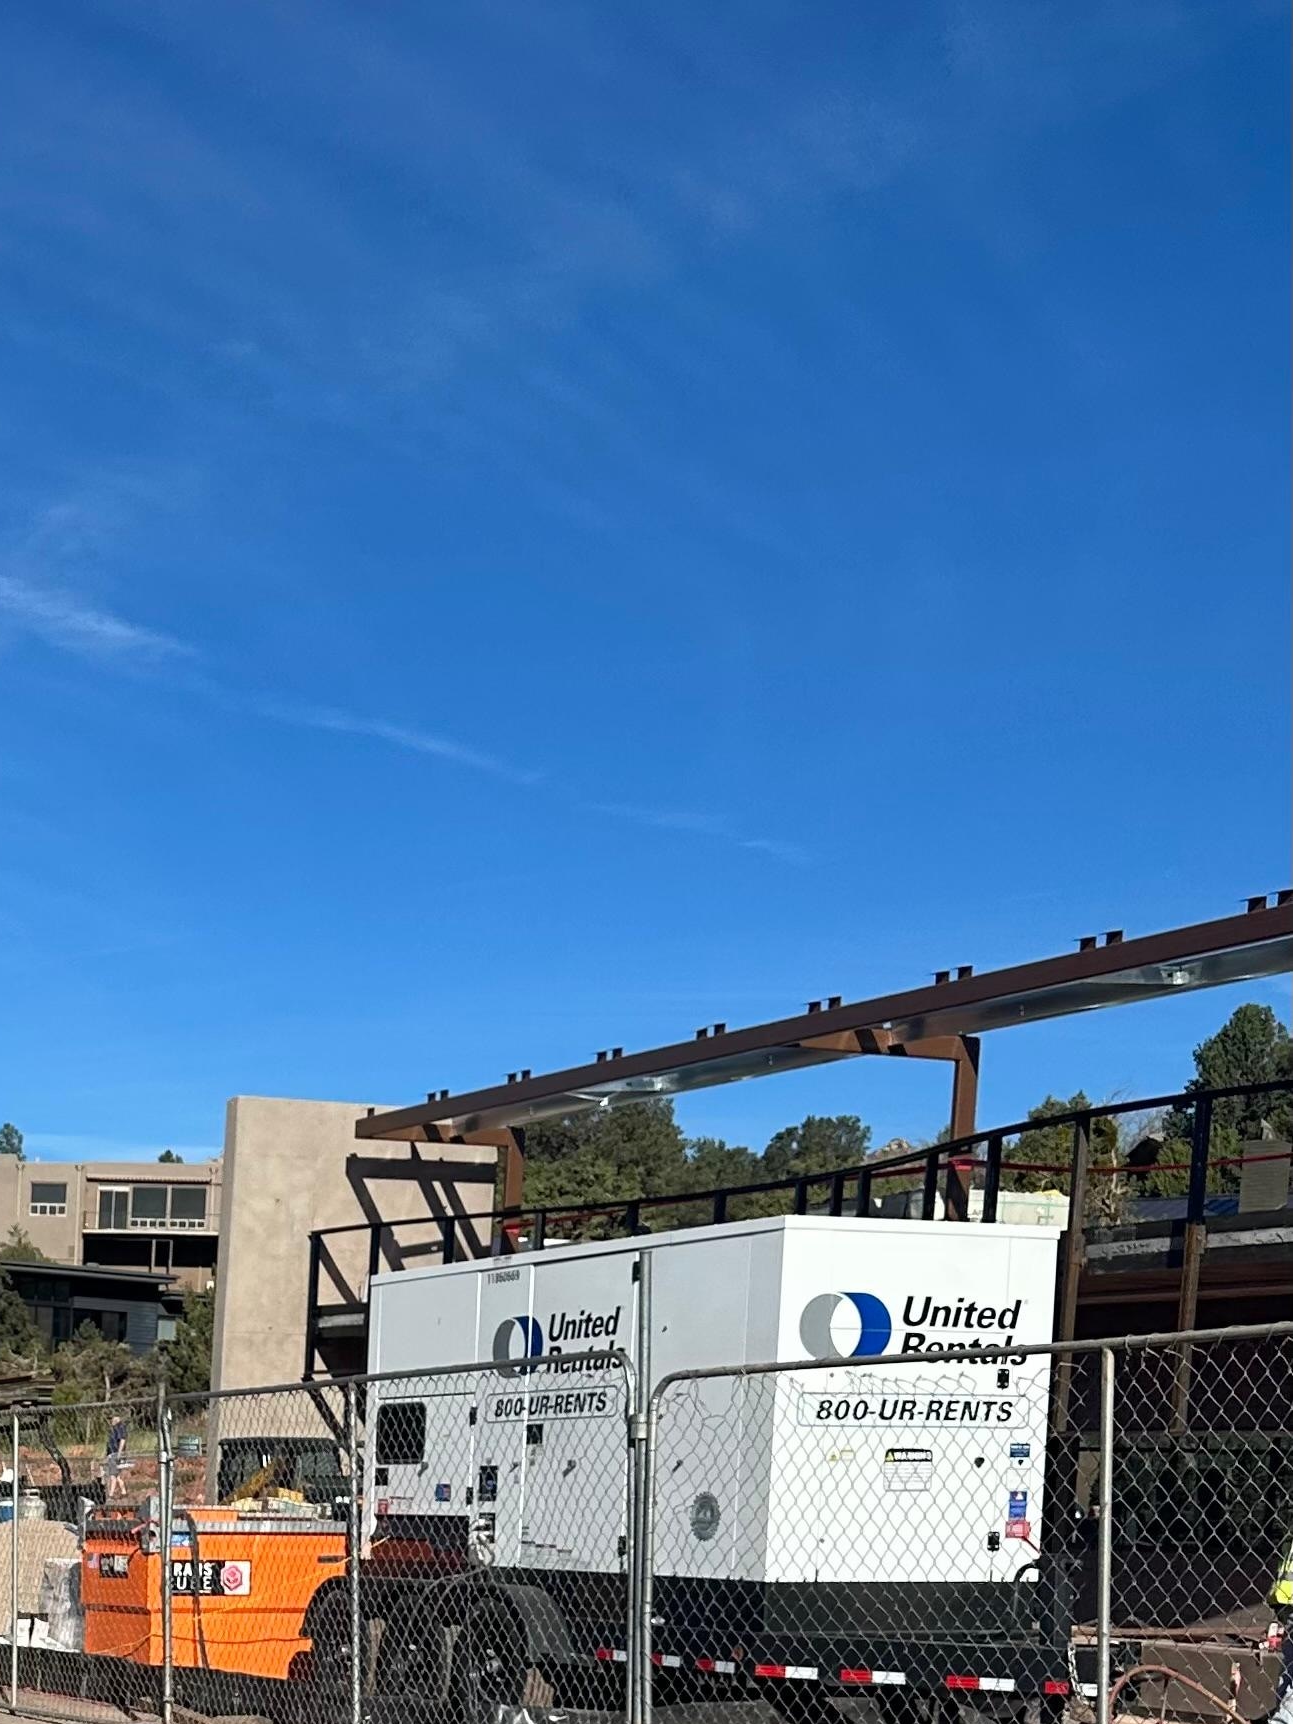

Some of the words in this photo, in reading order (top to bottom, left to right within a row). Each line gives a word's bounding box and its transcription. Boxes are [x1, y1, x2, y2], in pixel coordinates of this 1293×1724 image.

[548, 1306, 621, 1342] United
[902, 1296, 1022, 1329] United
[494, 1392, 607, 1418] 800-UR-RENTS
[816, 1399, 1013, 1422] 800-UR-RENTS
